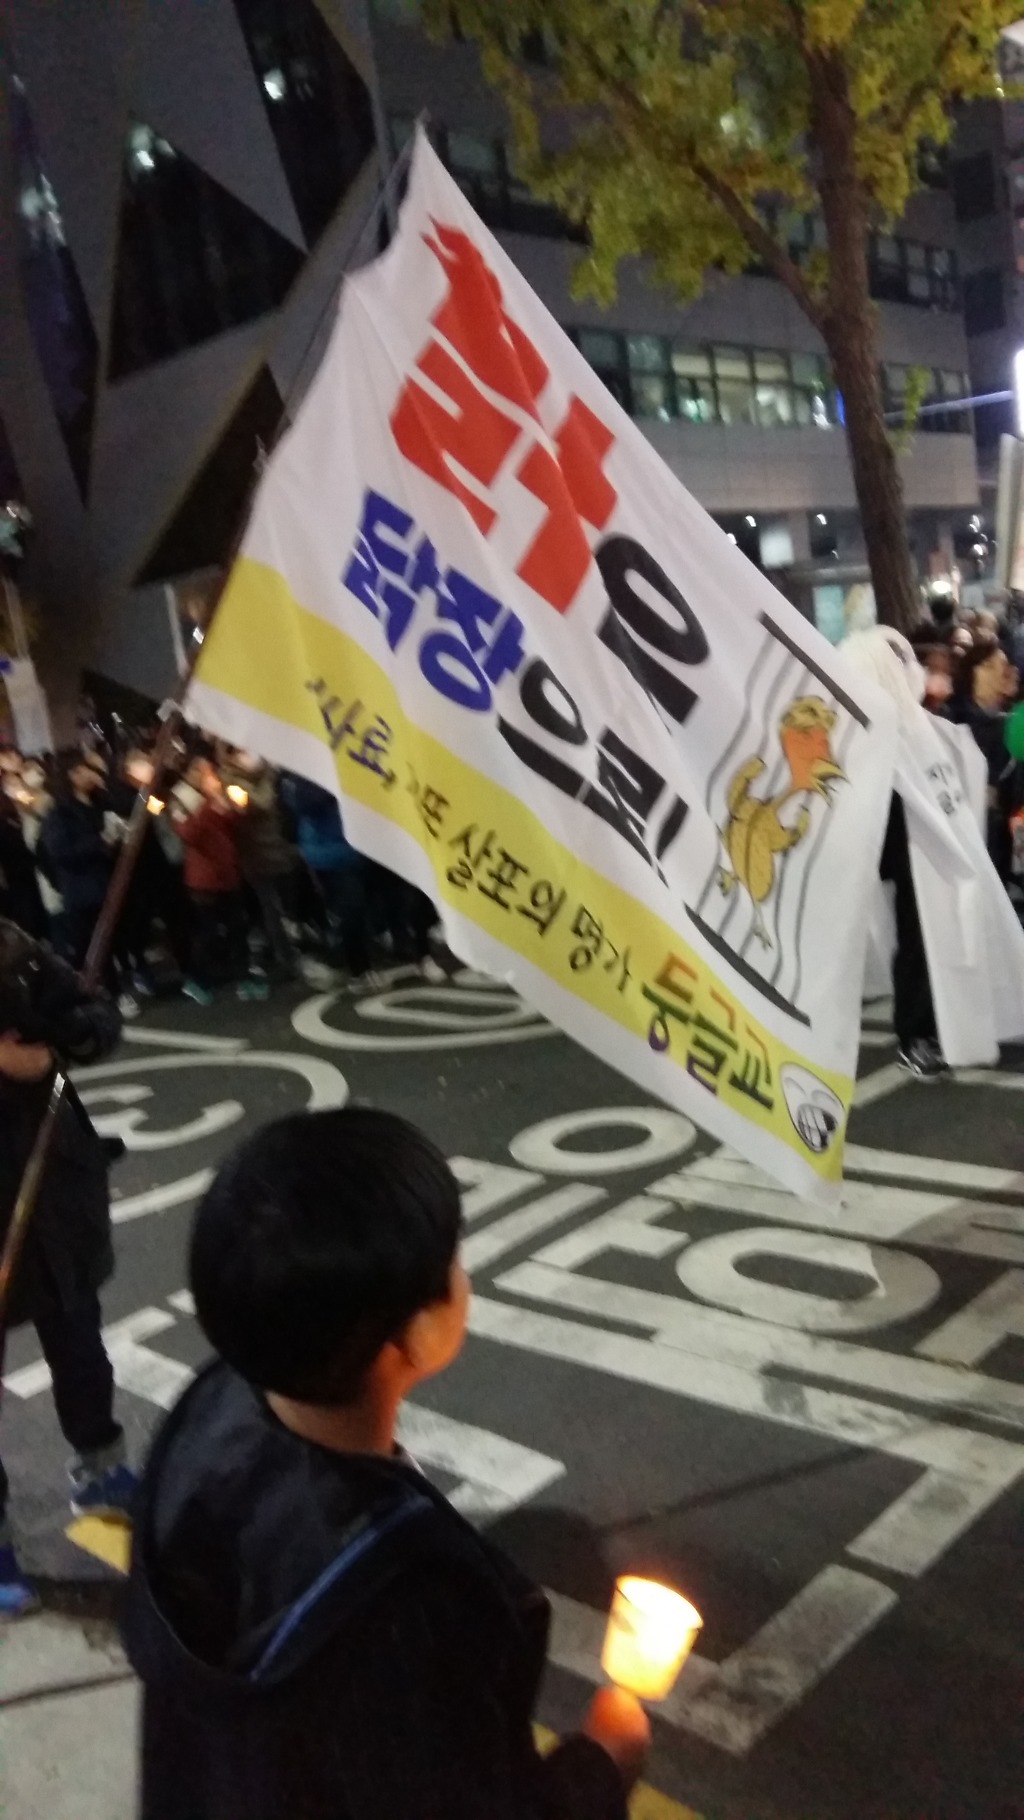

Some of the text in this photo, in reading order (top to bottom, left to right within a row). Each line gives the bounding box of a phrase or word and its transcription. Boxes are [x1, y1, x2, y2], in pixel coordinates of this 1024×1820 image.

[447, 823, 568, 937] 살포의
[569, 903, 632, 993] 명가
[642, 951, 775, 1113] 둥글교
